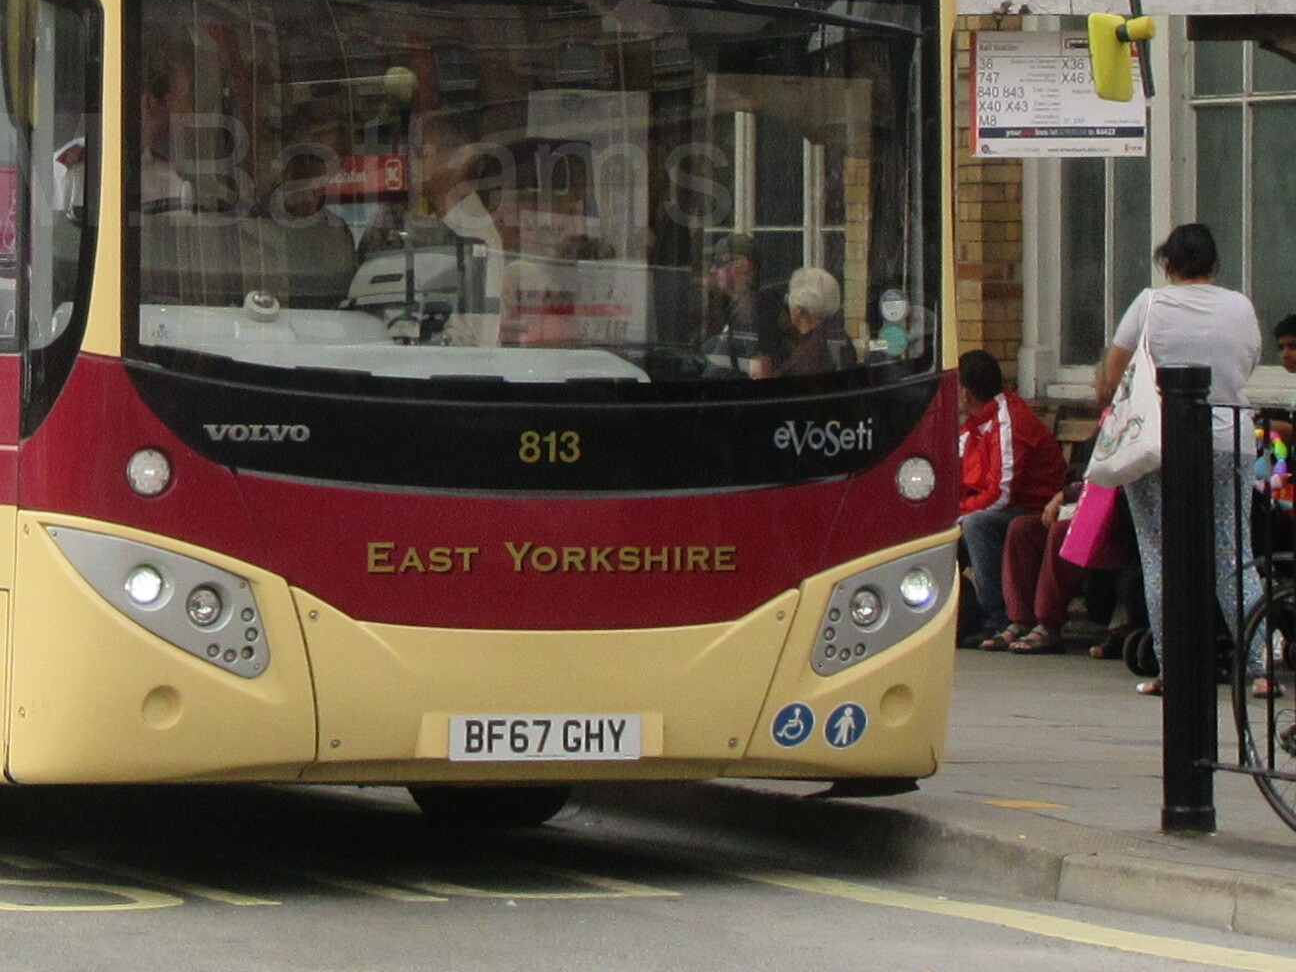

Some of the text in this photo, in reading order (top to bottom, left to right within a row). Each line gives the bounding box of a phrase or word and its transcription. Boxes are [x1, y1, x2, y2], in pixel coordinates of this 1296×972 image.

[1061, 59, 1085, 70] X36
[979, 72, 1000, 84] 747
[1061, 72, 1085, 84] X46
[978, 86, 1000, 98] 840
[1003, 86, 1025, 98] 843
[978, 100, 1002, 113] X40
[1005, 100, 1028, 113] X43
[979, 115, 997, 127] M8
[203, 424, 310, 442] VOLVO
[518, 430, 582, 465] 813
[366, 541, 737, 574] EAST YORKSHIRE
[464, 719, 626, 754] BF67 GHY
